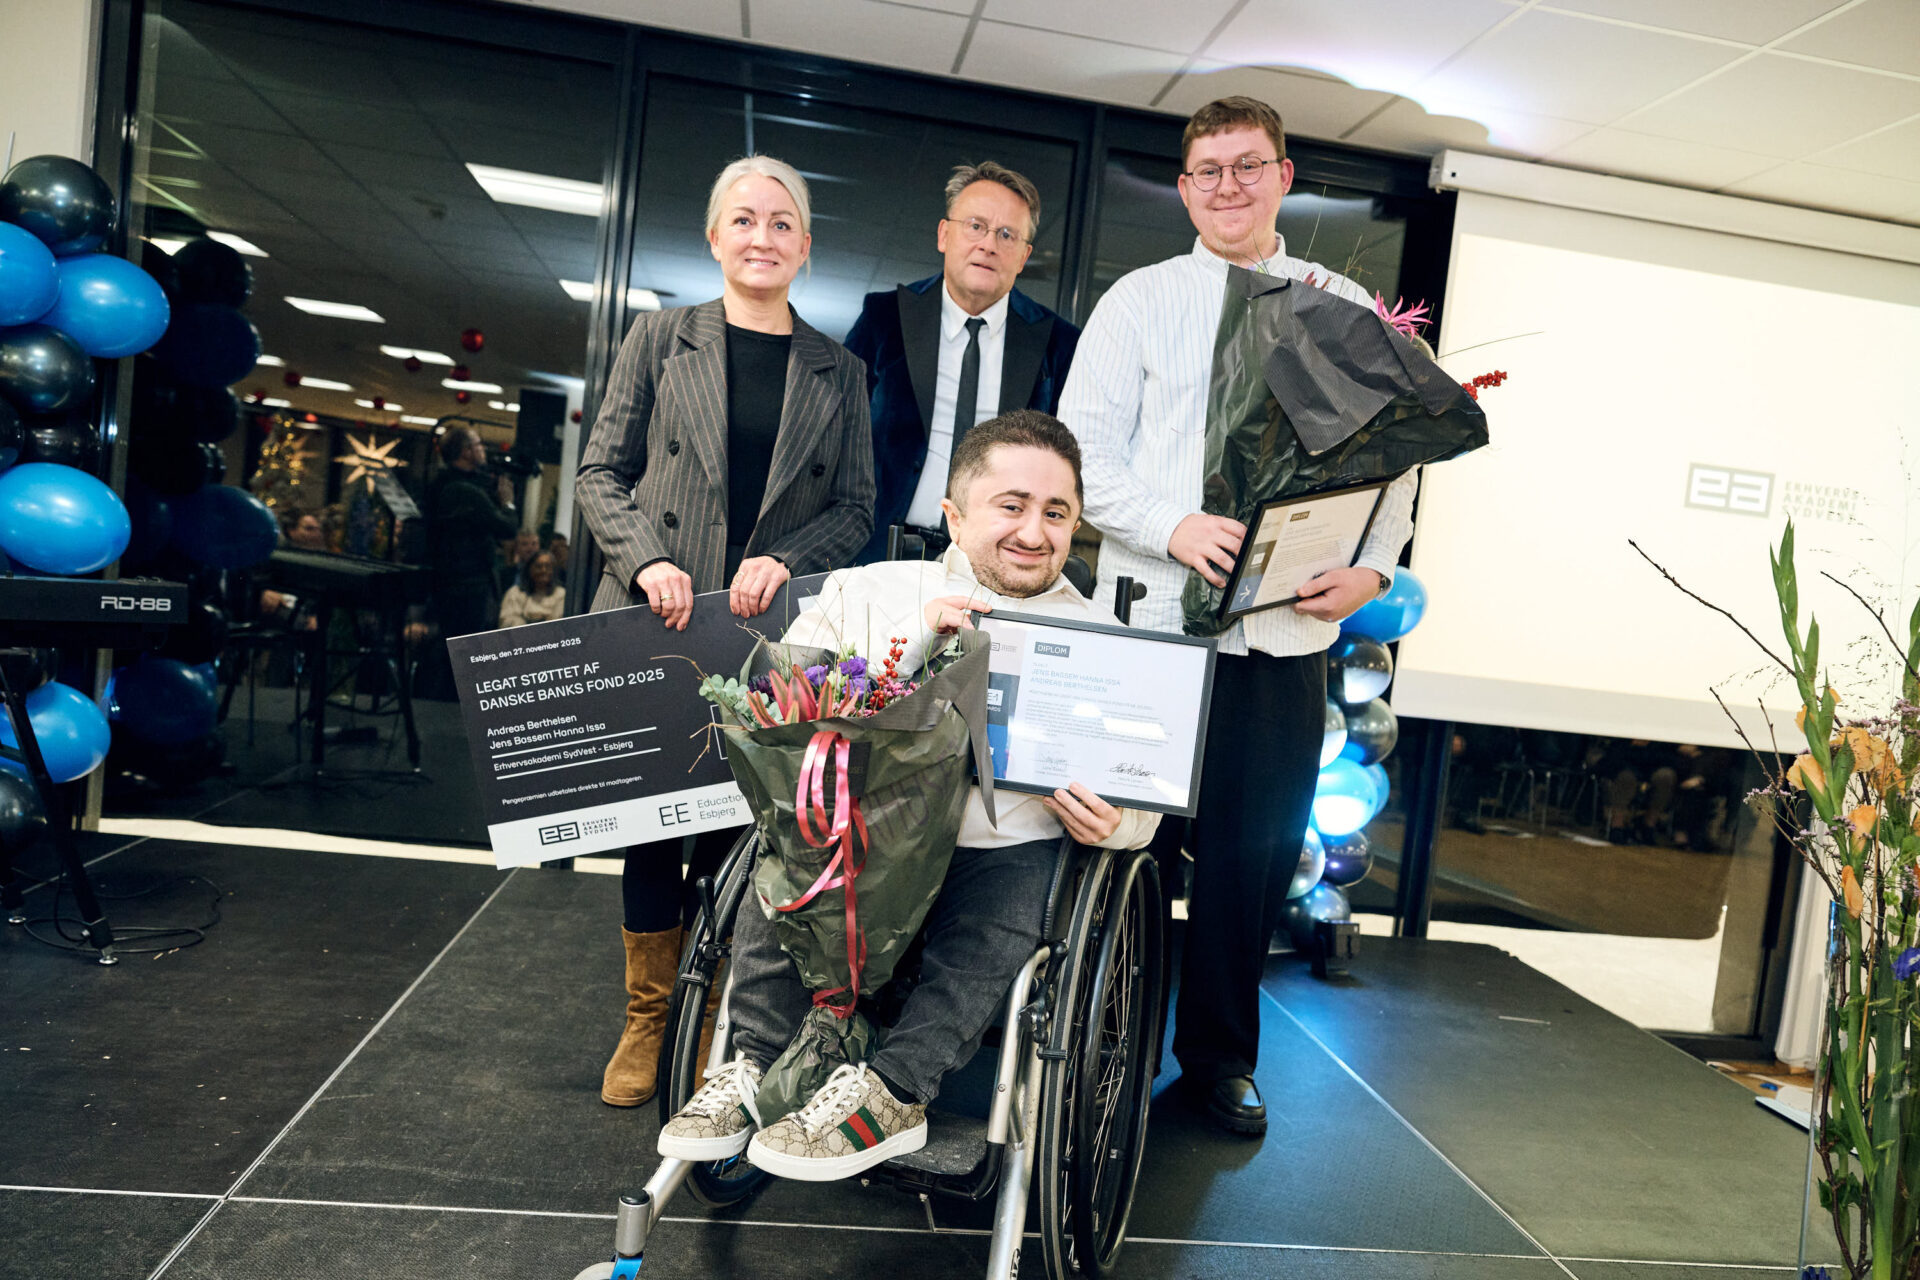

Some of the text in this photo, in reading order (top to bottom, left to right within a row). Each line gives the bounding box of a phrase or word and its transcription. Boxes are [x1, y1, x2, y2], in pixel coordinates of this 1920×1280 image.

[1783, 493, 1857, 512] AKADEMI
[101, 596, 171, 611] RD-88
[470, 637, 581, 663] Esbjerg, den 27. november 2025
[1037, 644, 1067, 655] DIPLOM
[475, 661, 601, 694] LEGAT STØTTET AF
[479, 668, 665, 711] DANSKE BANKS FOND 2025
[487, 714, 577, 738] Andreas Berthelsen
[489, 722, 606, 750] Jens Bassem Hanna Issa
[493, 752, 562, 772] Erhvervsakademi
[563, 746, 597, 760] SydVest
[603, 739, 634, 754] Esbjerg
[577, 783, 598, 792] direkte
[582, 816, 617, 827] ERHVERVS
[659, 802, 692, 827] EE
[700, 807, 736, 820] Esbjerg
[583, 822, 618, 831] AKADEMI
[584, 826, 619, 836] SYDVEST
